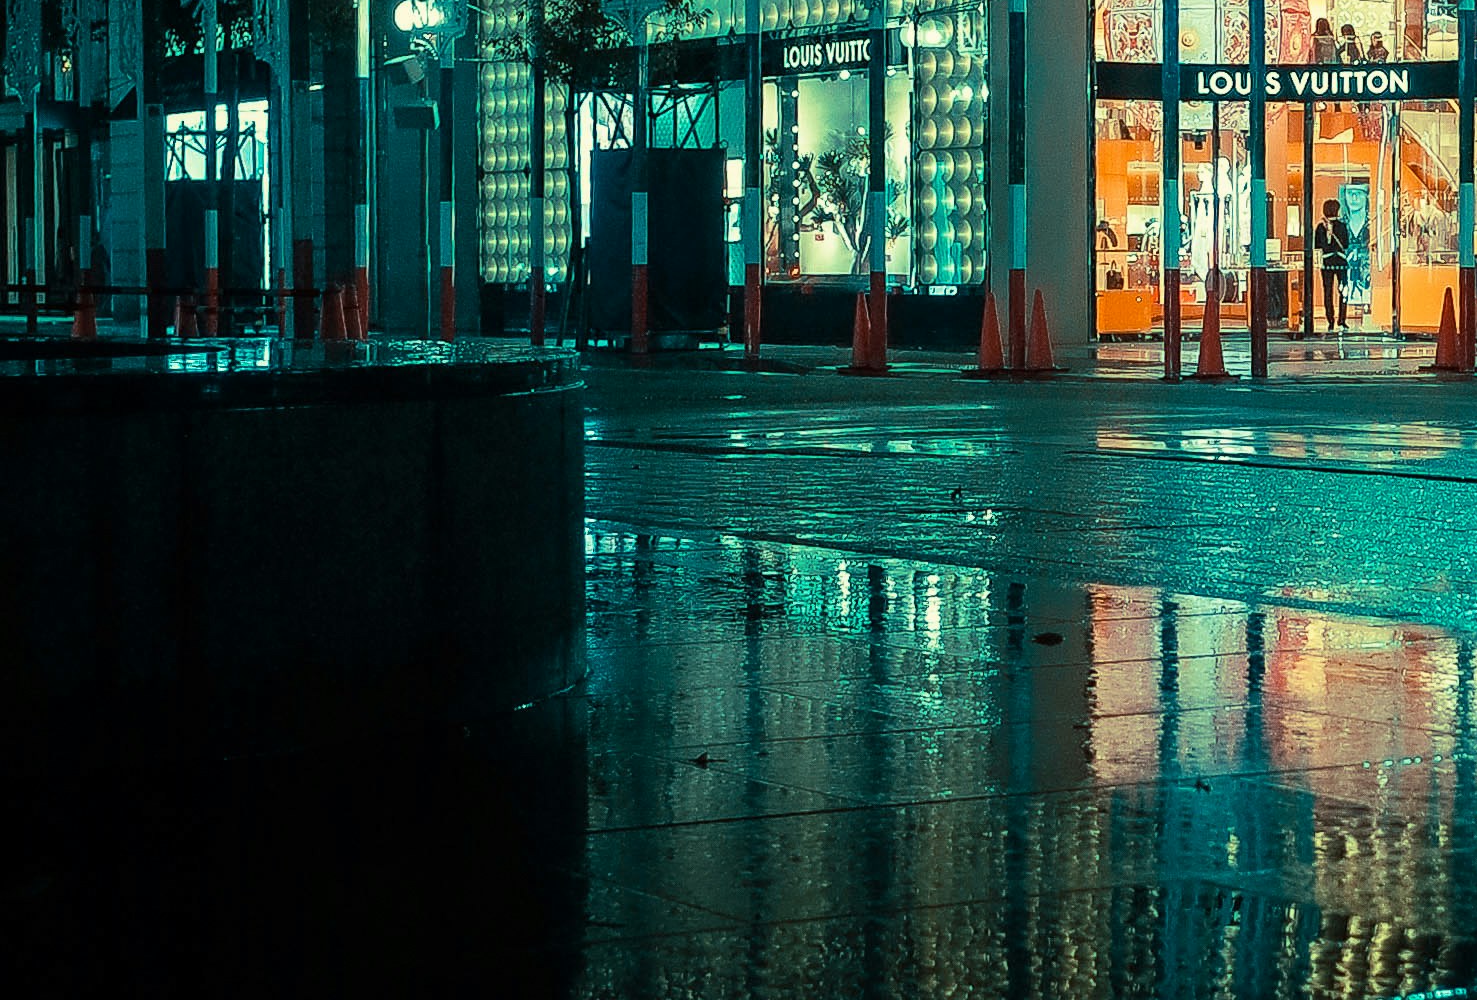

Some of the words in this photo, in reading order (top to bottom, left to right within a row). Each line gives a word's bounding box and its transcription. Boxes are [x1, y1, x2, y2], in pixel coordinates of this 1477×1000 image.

[783, 43, 823, 69] LOUIS
[825, 38, 871, 64] VUITTO
[1197, 70, 1281, 95] LOUS
[1289, 69, 1409, 95] VUITTON
